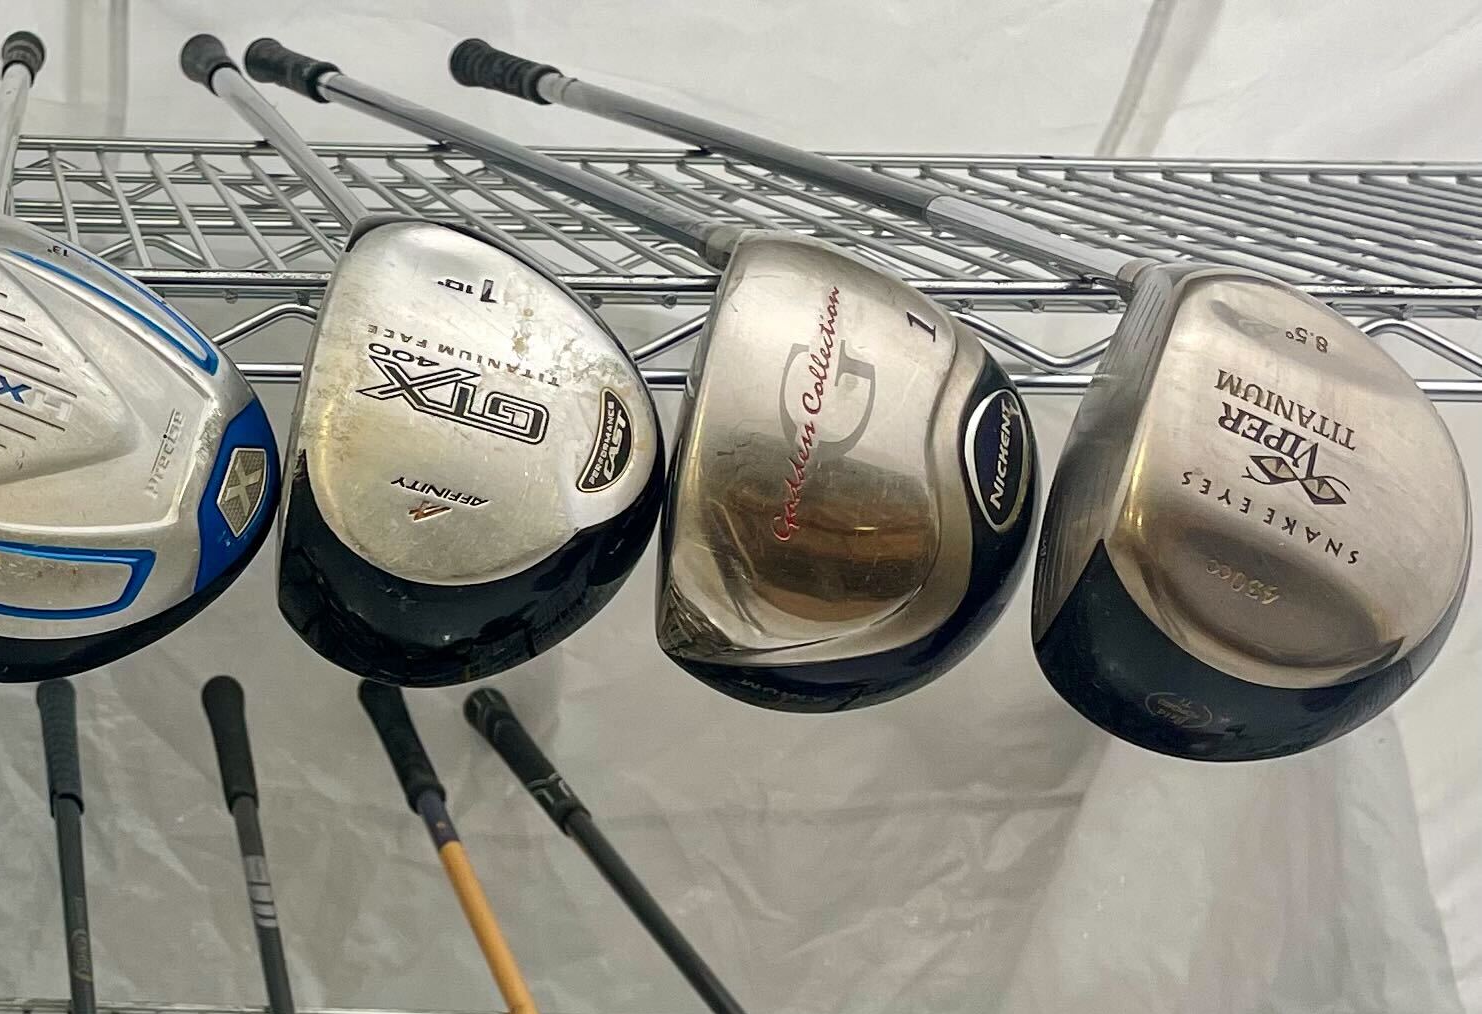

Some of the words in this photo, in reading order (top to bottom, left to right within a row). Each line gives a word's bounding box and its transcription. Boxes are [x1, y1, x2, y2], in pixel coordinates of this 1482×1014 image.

[479, 280, 498, 304] 1
[367, 323, 427, 348] FACE
[801, 284, 840, 417] Collection
[907, 310, 937, 343] 1
[368, 341, 440, 368] 400
[438, 342, 561, 387] TITANIUM
[1214, 368, 1358, 452] TITANIUM
[589, 401, 616, 486] PERFORMANCE
[603, 407, 628, 482] CAST
[989, 397, 1021, 510] NICKENT
[1218, 402, 1320, 476] VIPER
[391, 476, 491, 507] AFFINITY
[1181, 469, 1252, 515] EYES
[1263, 507, 1359, 564] SNAKE
